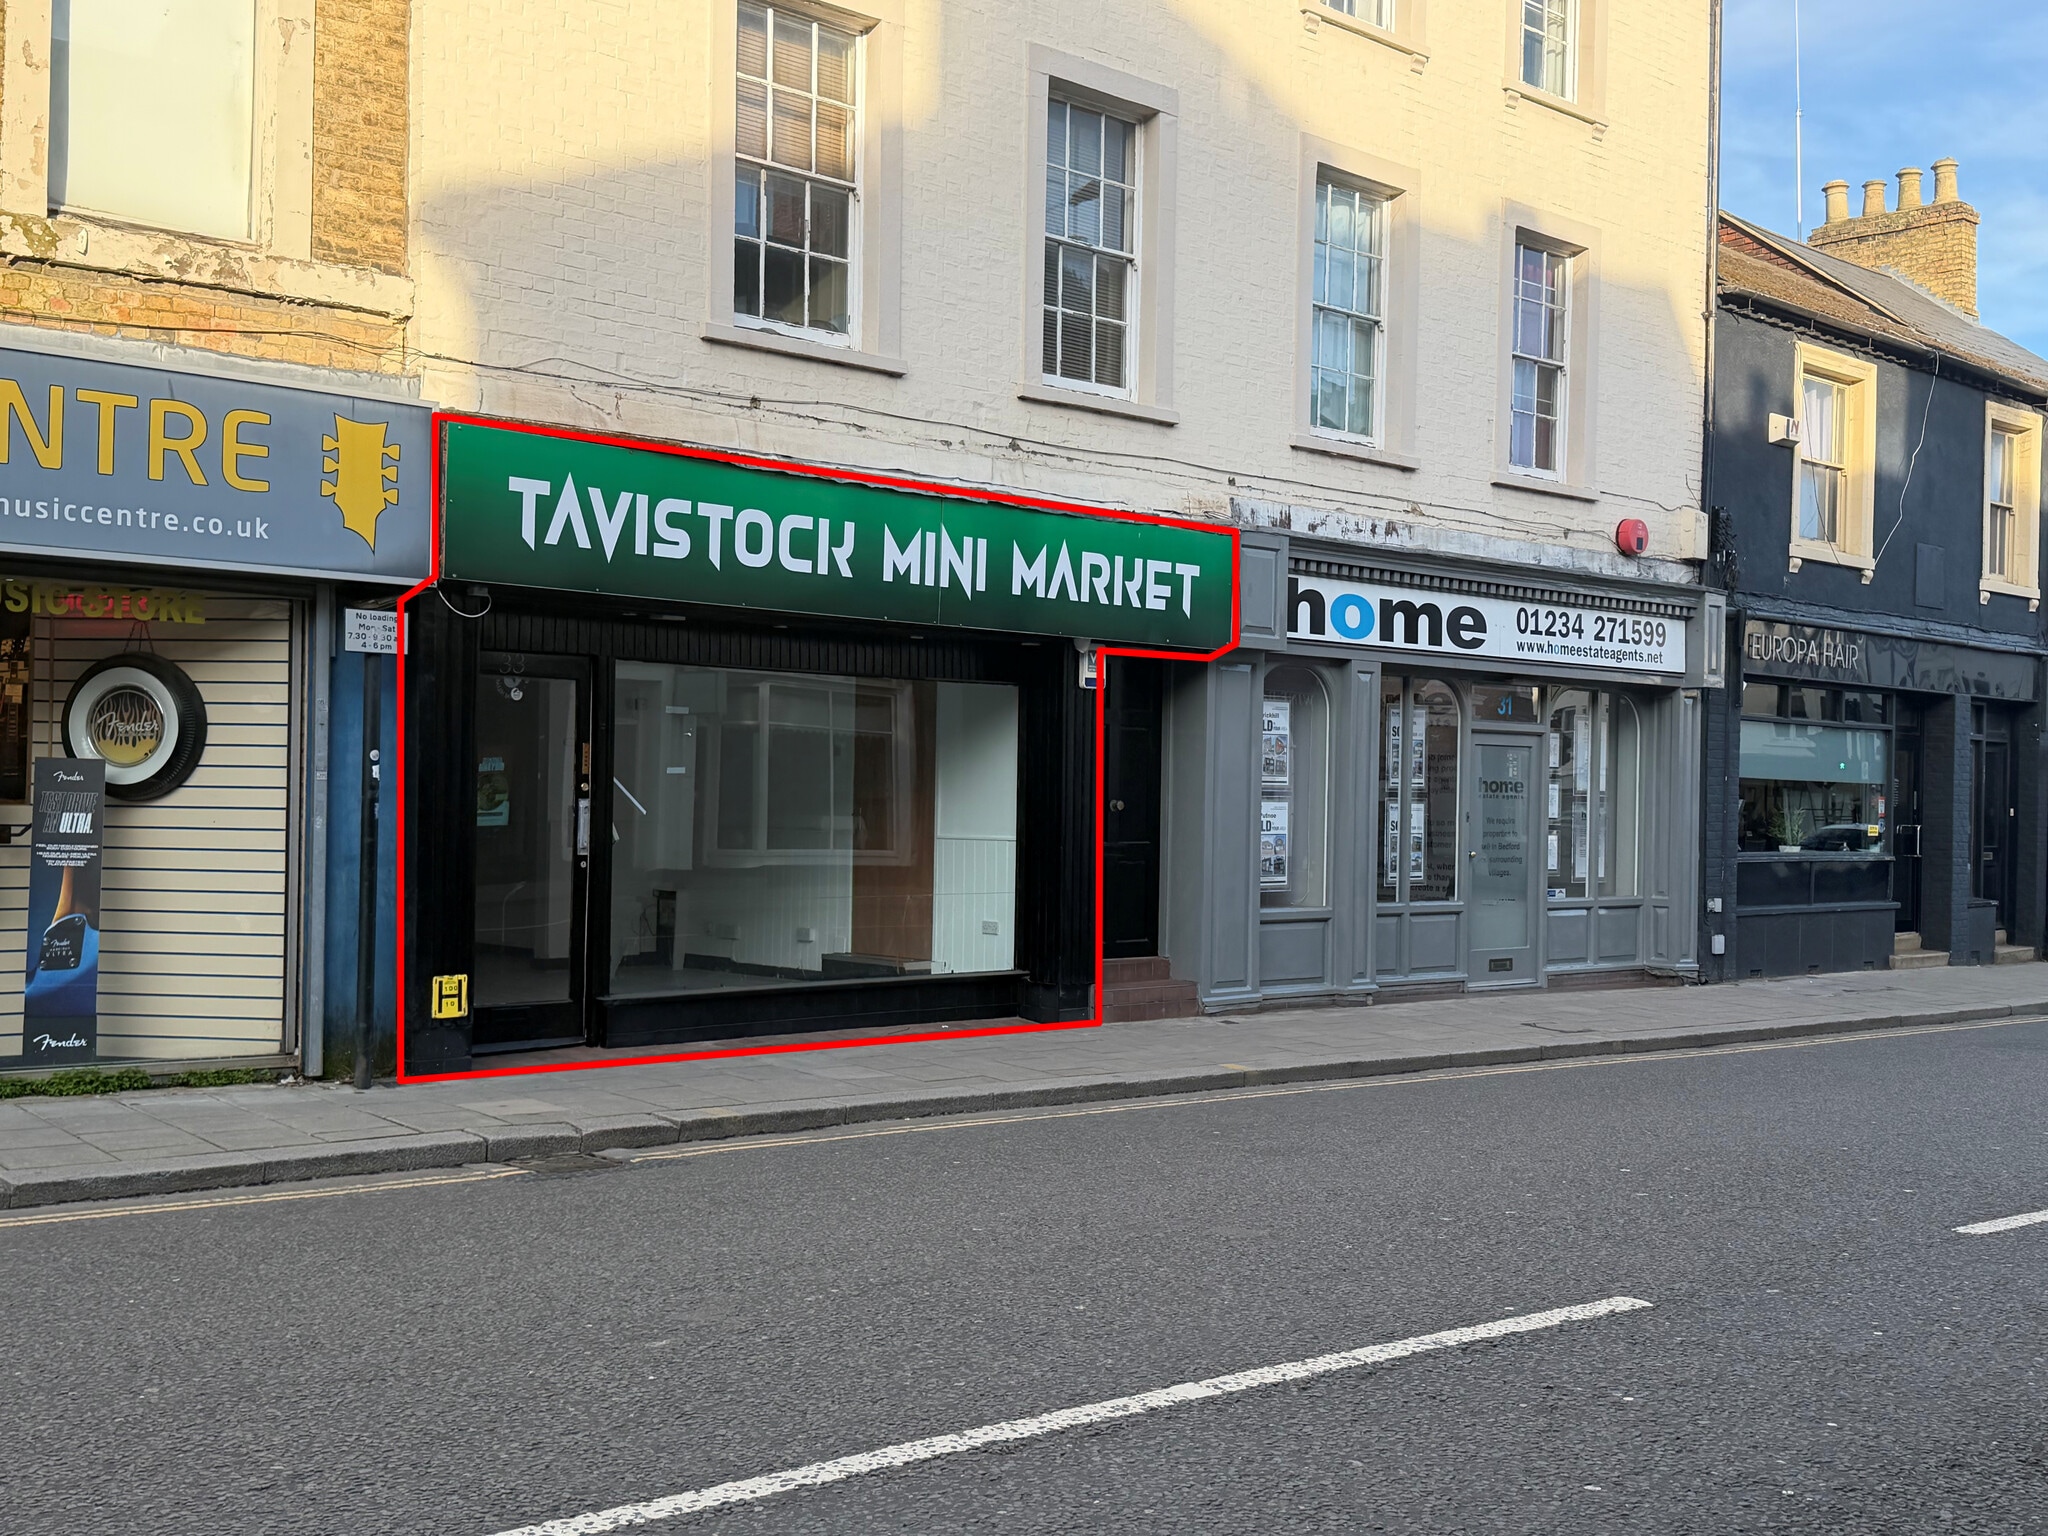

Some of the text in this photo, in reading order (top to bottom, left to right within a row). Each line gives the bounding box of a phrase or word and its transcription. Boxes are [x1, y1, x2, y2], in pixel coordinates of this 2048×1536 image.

[0, 378, 271, 492] NTRE
[508, 471, 1201, 620] TAVISTOCK MINI MARKET
[0, 582, 69, 616] SIC
[82, 585, 206, 625] STORE
[1287, 577, 1488, 650] home
[356, 612, 367, 620] No
[347, 632, 367, 640] 7.30
[382, 624, 396, 633] Sat
[1516, 606, 1667, 649] 01234 271599
[1516, 640, 1664, 665] www.homeestateagents.net
[1751, 633, 1859, 670] EUROPA HAIR
[1497, 696, 1513, 716] 31
[97, 710, 159, 738] Fender
[53, 770, 84, 783] Fender
[1478, 777, 1525, 794] home
[39, 790, 98, 813] TEST DRIVE
[43, 811, 93, 834] AN ULTRA.
[1498, 842, 1520, 850] Bedford
[1488, 856, 1522, 864] surrounding
[51, 938, 71, 948] Fender
[33, 1033, 88, 1051] Fender
